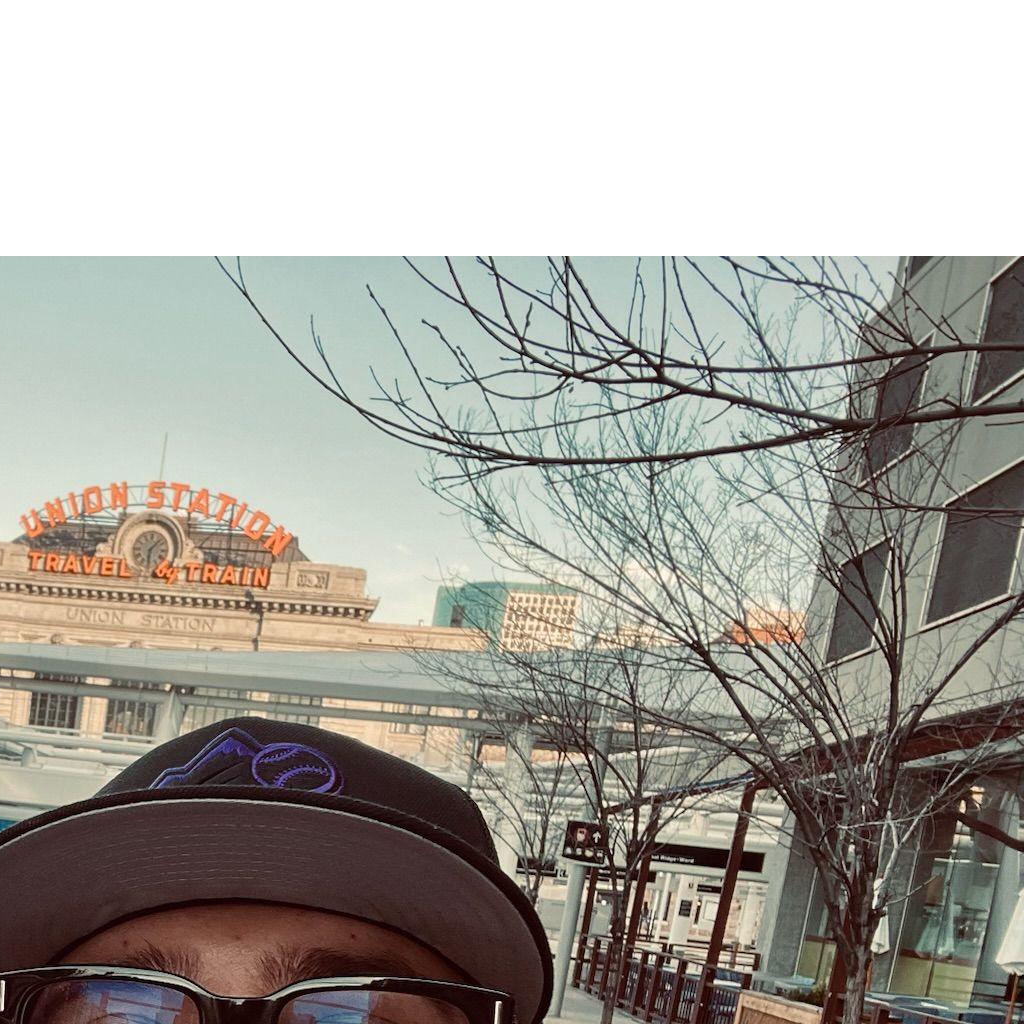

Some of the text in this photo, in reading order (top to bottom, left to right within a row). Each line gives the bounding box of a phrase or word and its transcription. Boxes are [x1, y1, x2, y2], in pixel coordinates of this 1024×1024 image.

[19, 481, 129, 538] UNION
[146, 481, 294, 557] STATION
[27, 550, 272, 588] TRAVEL by TRAIN
[66, 608, 217, 633] UNION STATION
